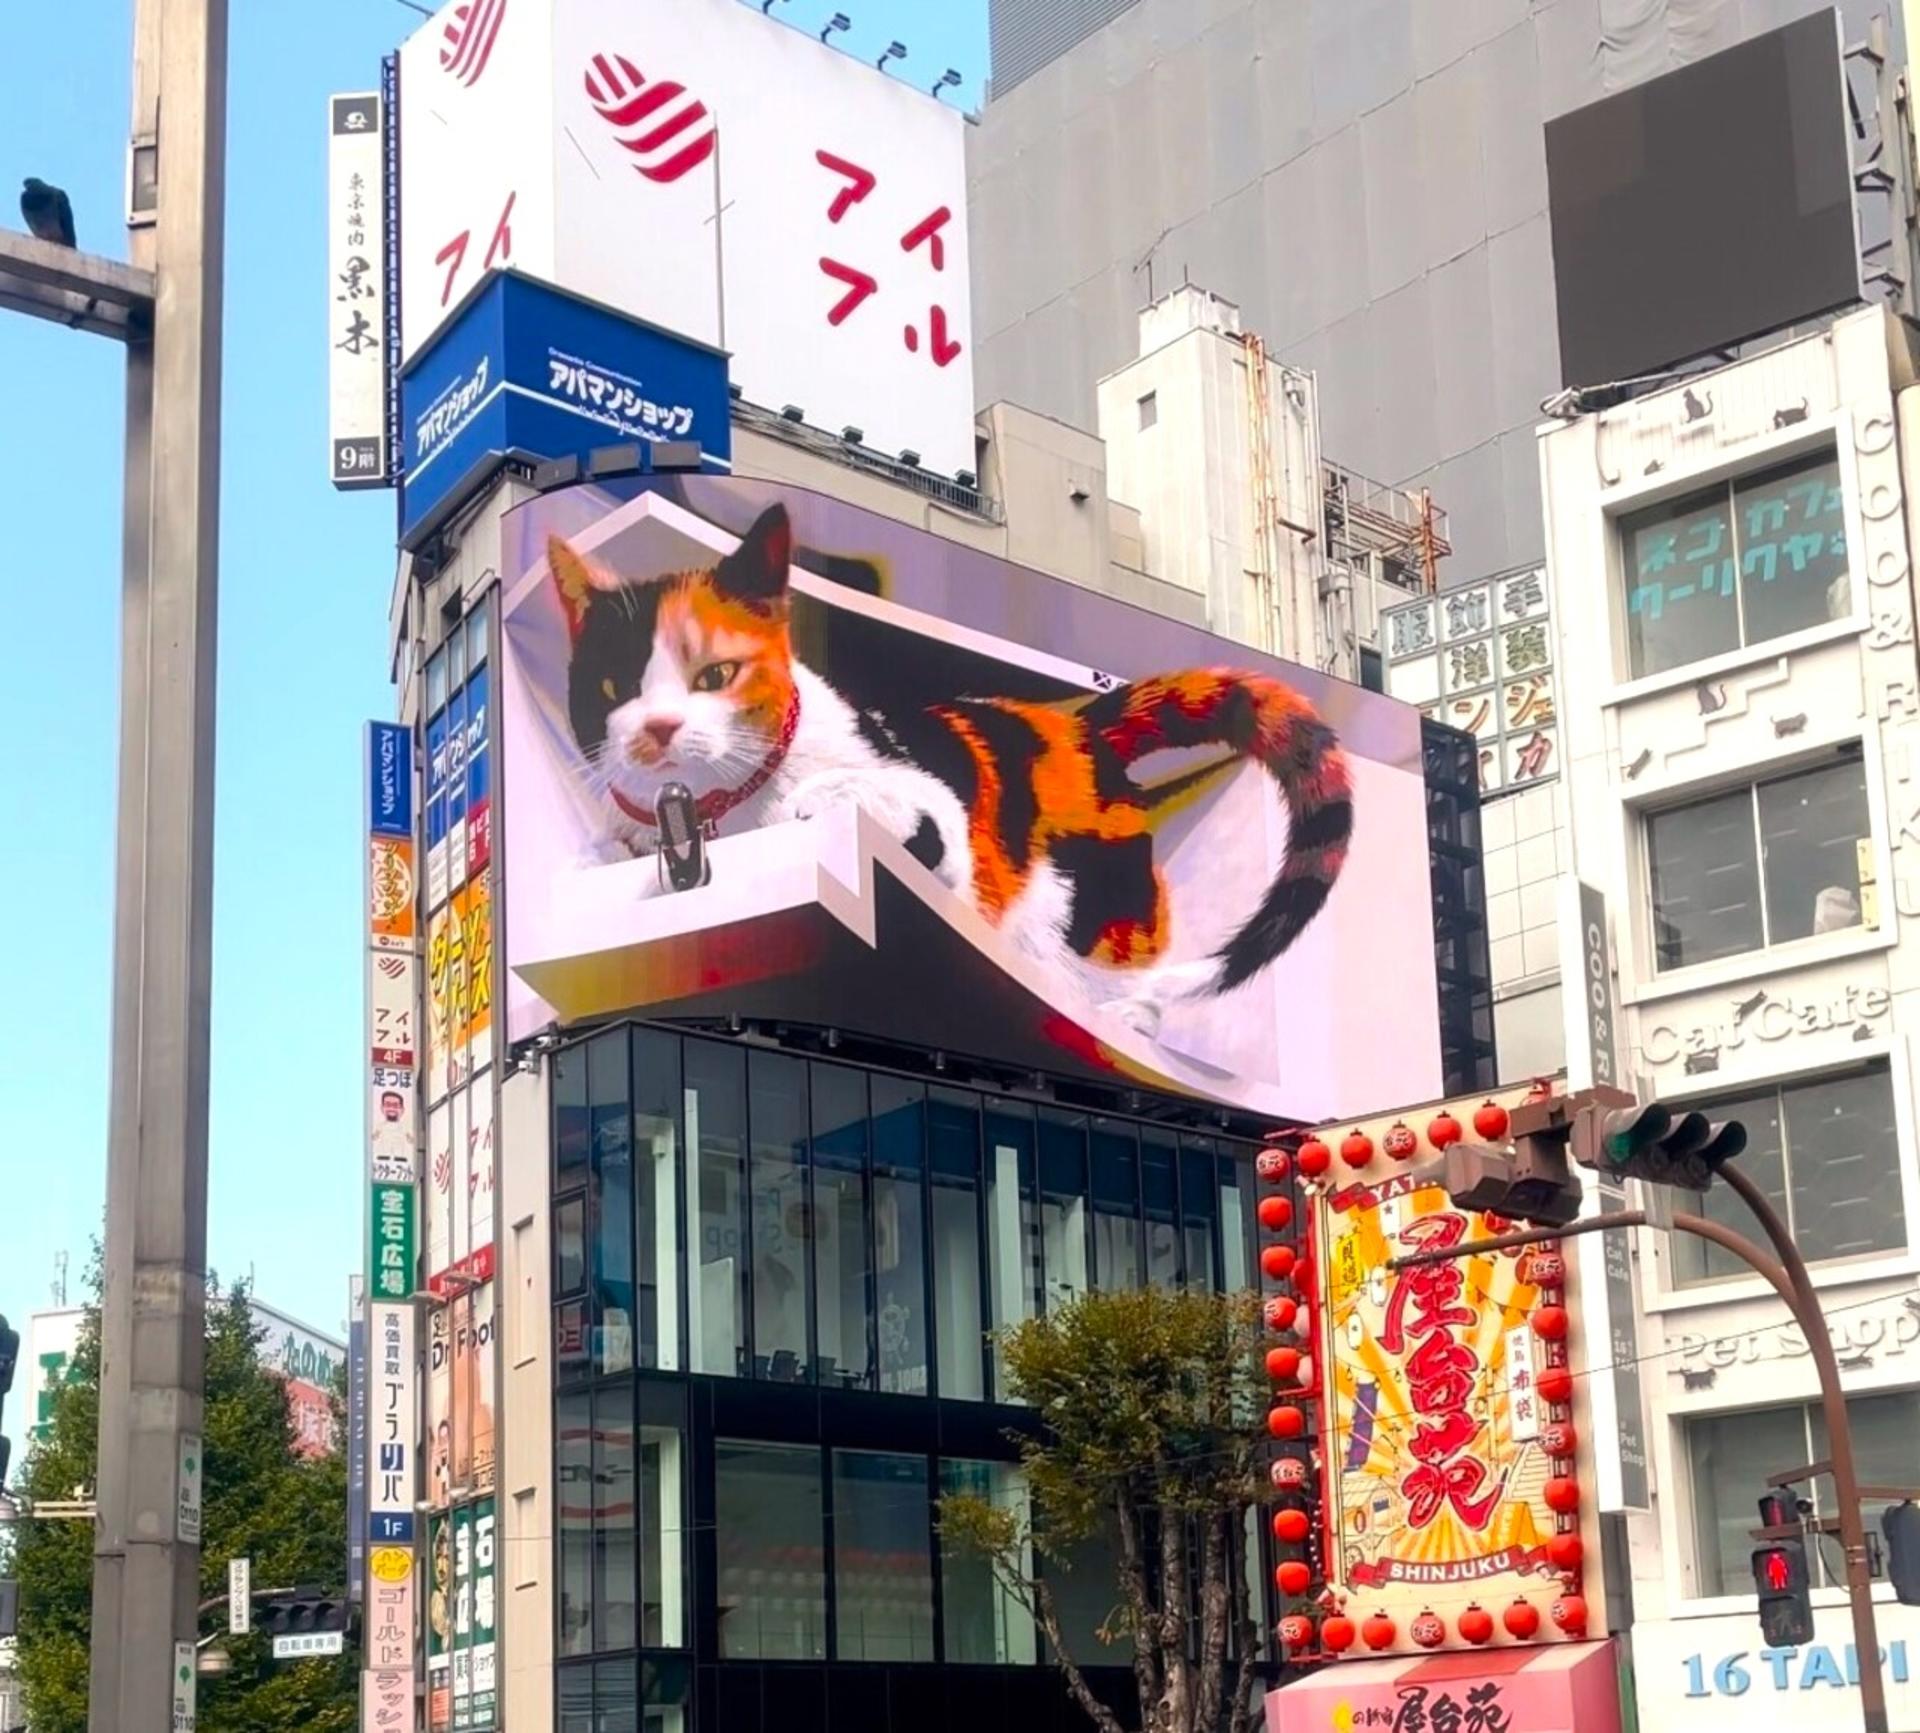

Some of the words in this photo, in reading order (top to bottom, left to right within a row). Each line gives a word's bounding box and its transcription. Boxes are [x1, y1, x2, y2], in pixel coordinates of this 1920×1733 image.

[549, 360, 694, 434] アパマンショップ
[340, 446, 376, 471] 9階
[383, 1052, 402, 1064] 4F
[380, 1188, 406, 1296] 宝石広場
[381, 1381, 404, 1504] ブラリバ
[383, 1518, 403, 1537] 1F
[1390, 1552, 1511, 1582] SHINJUKU
[1682, 1651, 1751, 1699] 16
